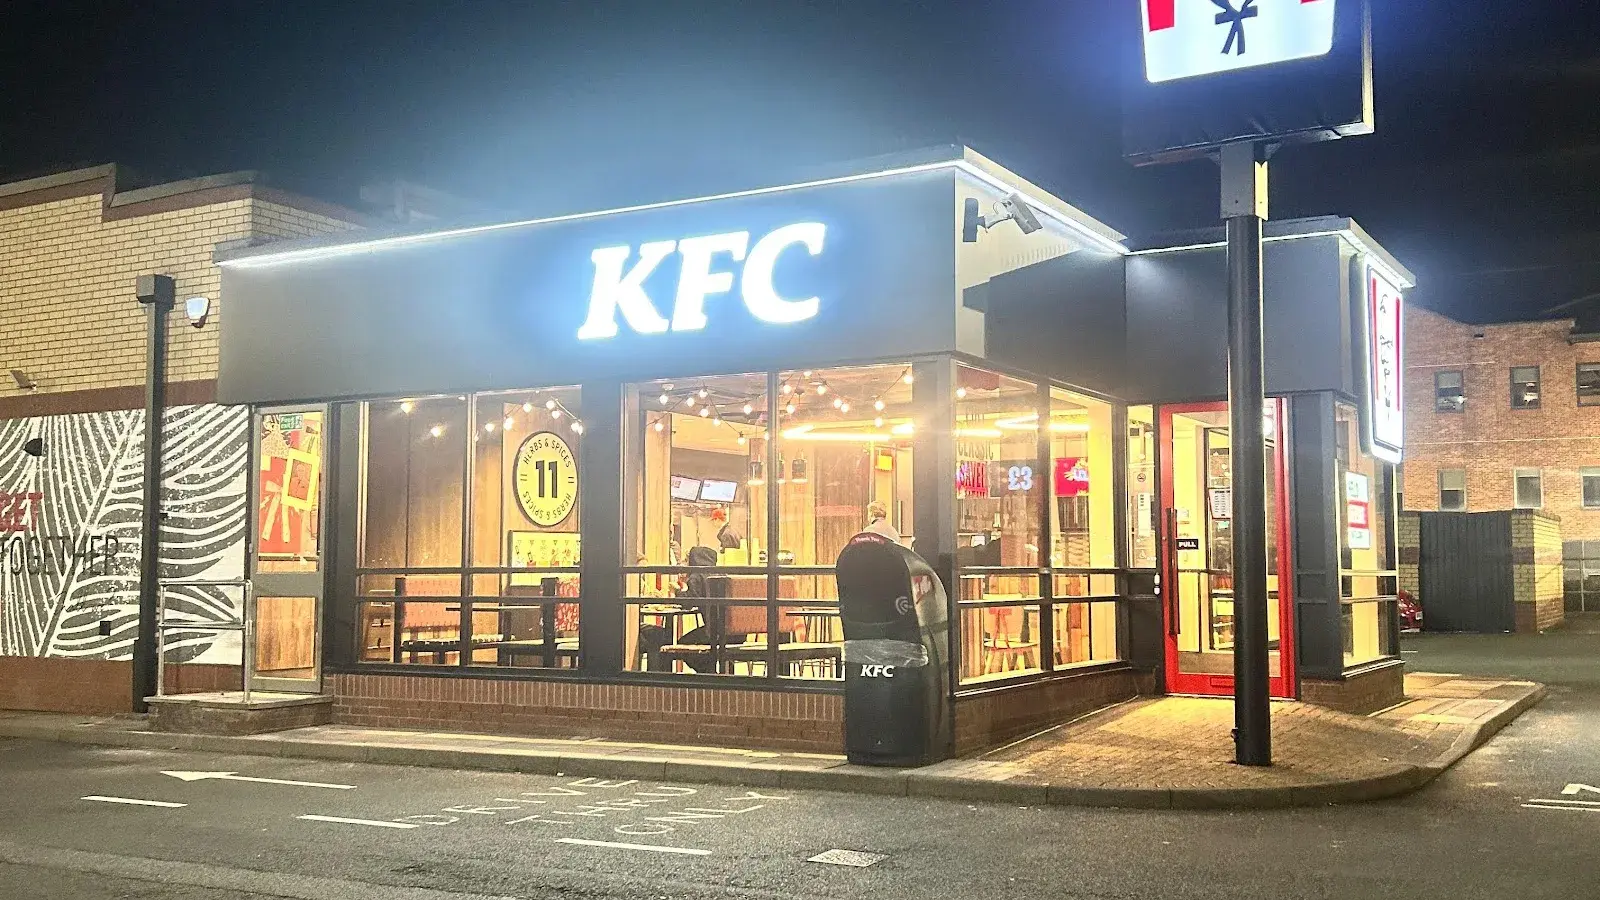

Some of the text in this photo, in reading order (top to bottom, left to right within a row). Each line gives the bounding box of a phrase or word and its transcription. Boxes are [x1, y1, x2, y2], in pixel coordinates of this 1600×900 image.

[577, 222, 826, 340] KFC
[551, 440, 572, 468] SPICES
[535, 460, 558, 498] 11
[1008, 465, 1034, 491] £3
[0, 535, 119, 576] TOGETHER
[861, 664, 895, 678] KFC
[614, 791, 789, 835] ONLY
